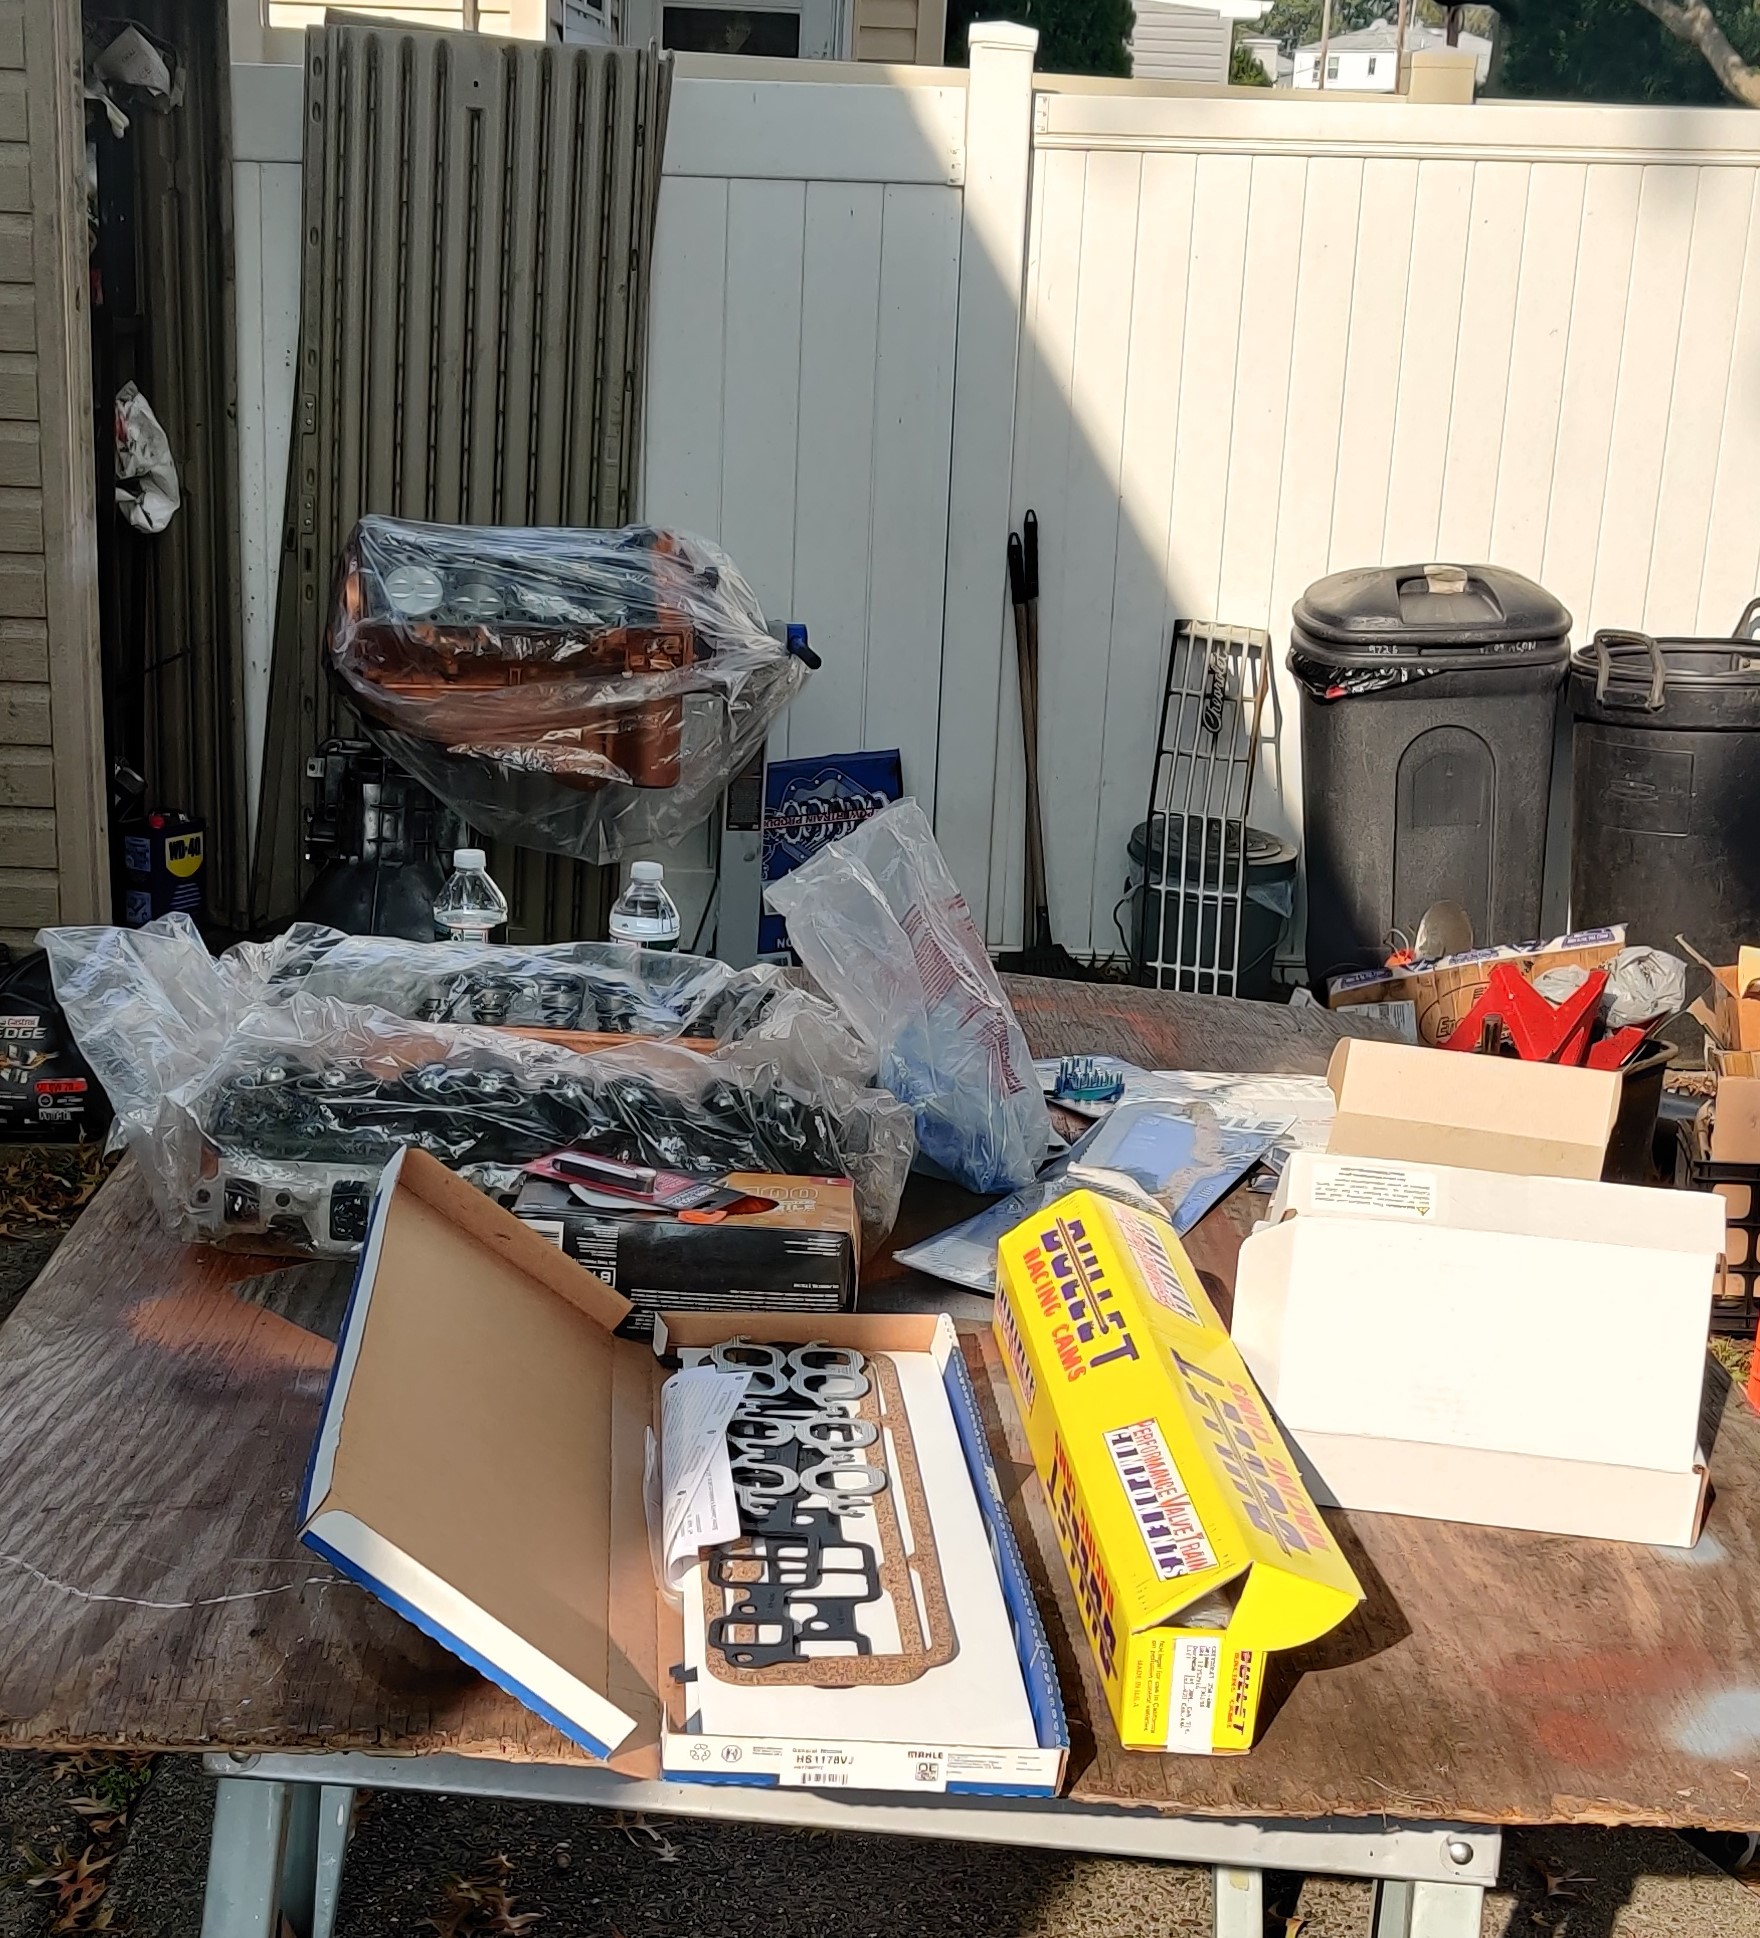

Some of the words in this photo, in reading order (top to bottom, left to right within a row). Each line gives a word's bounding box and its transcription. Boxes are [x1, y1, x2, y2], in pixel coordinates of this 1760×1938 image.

[1202, 645, 1228, 732] Chevrolet
[168, 836, 201, 861] WD-40
[806, 808, 875, 825] POWERTRAIN
[7, 1017, 37, 1027] Castrol
[1022, 1246, 1062, 1318] RACING
[1051, 1323, 1087, 1383] CAMS
[1040, 1218, 1140, 1369] BULLET
[1227, 1379, 1274, 1445] CAMS
[1132, 1417, 1178, 1498] PERFORMANCE
[1170, 1347, 1312, 1558] BULLET
[1159, 1492, 1195, 1537] VALVE
[1264, 1455, 1332, 1553] RACING
[1174, 1531, 1218, 1572] TRAIN
[1233, 1650, 1253, 1736] BULLET
[907, 1750, 944, 1760] MAHLE
